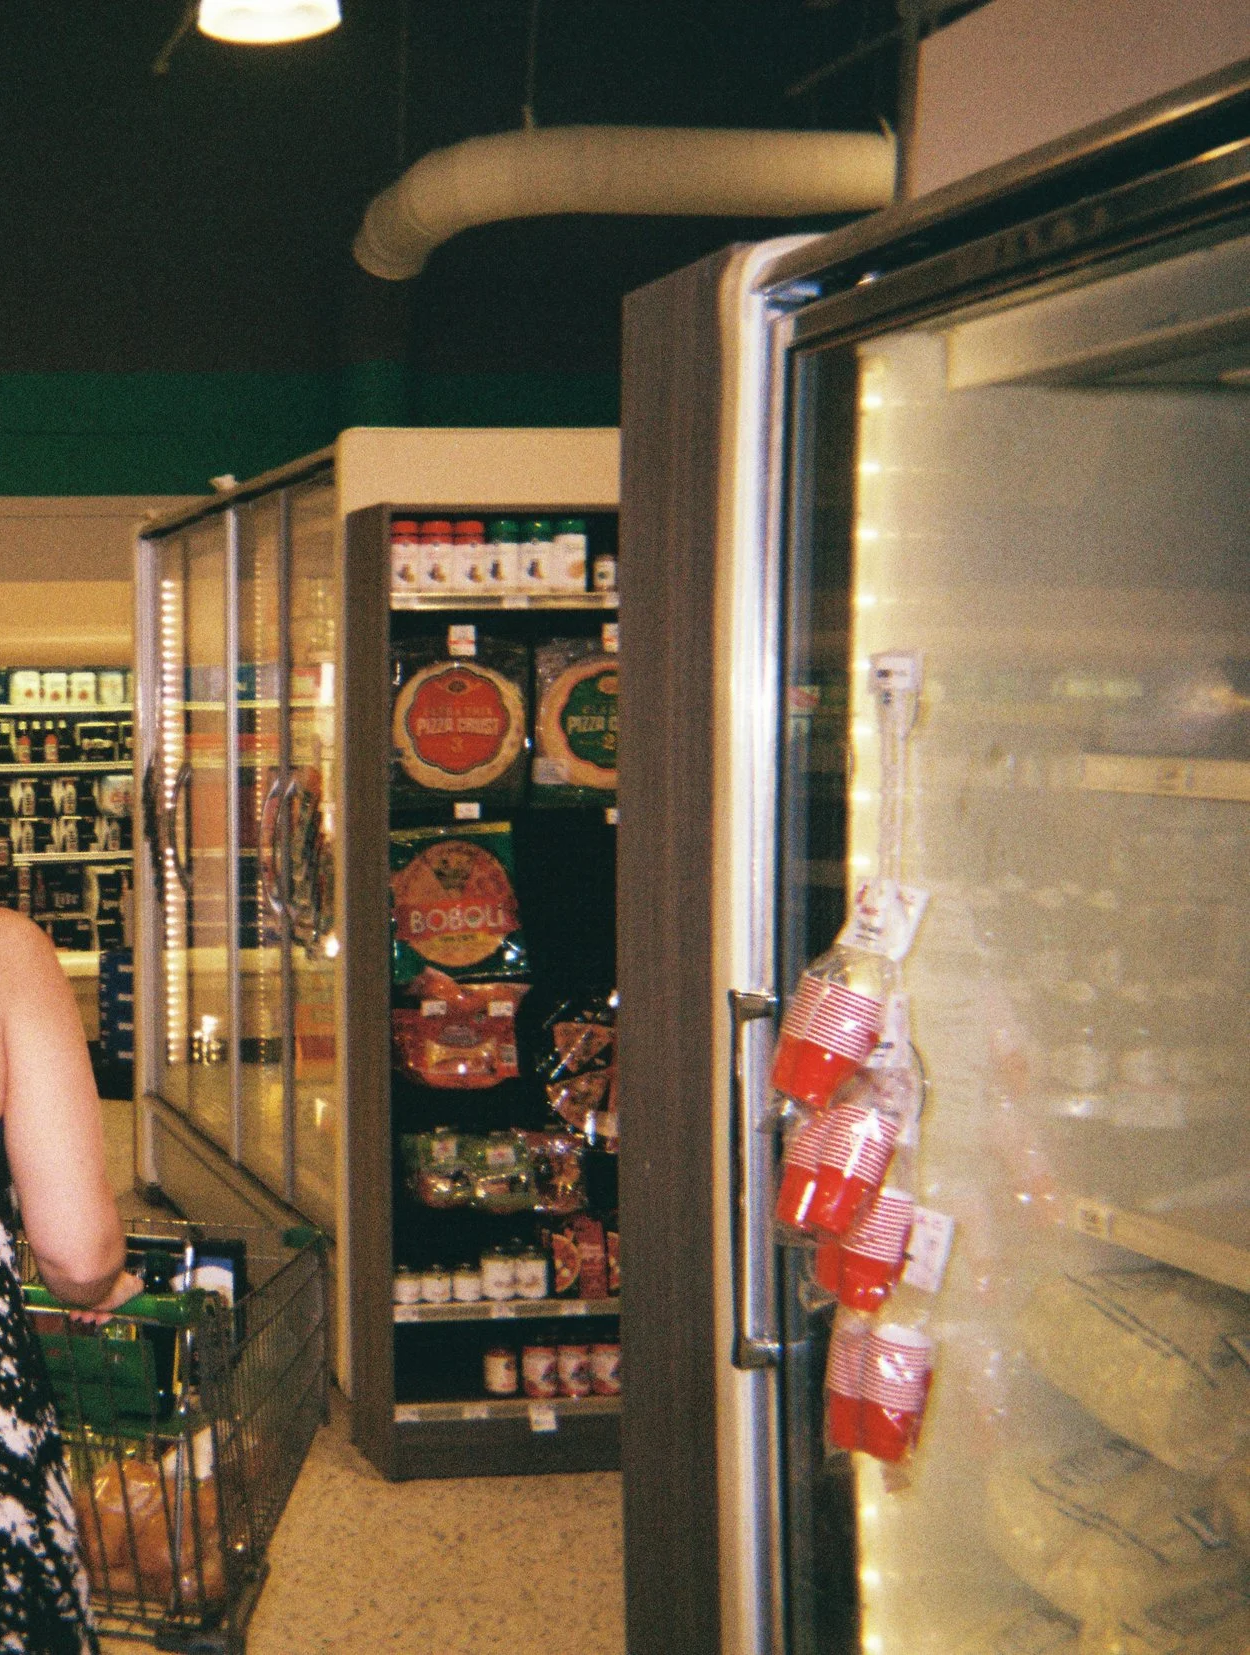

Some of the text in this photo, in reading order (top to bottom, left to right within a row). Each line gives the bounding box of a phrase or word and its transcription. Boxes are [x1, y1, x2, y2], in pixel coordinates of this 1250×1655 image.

[416, 717, 500, 737] PIZZA CRUST
[566, 716, 605, 735] PIZZA
